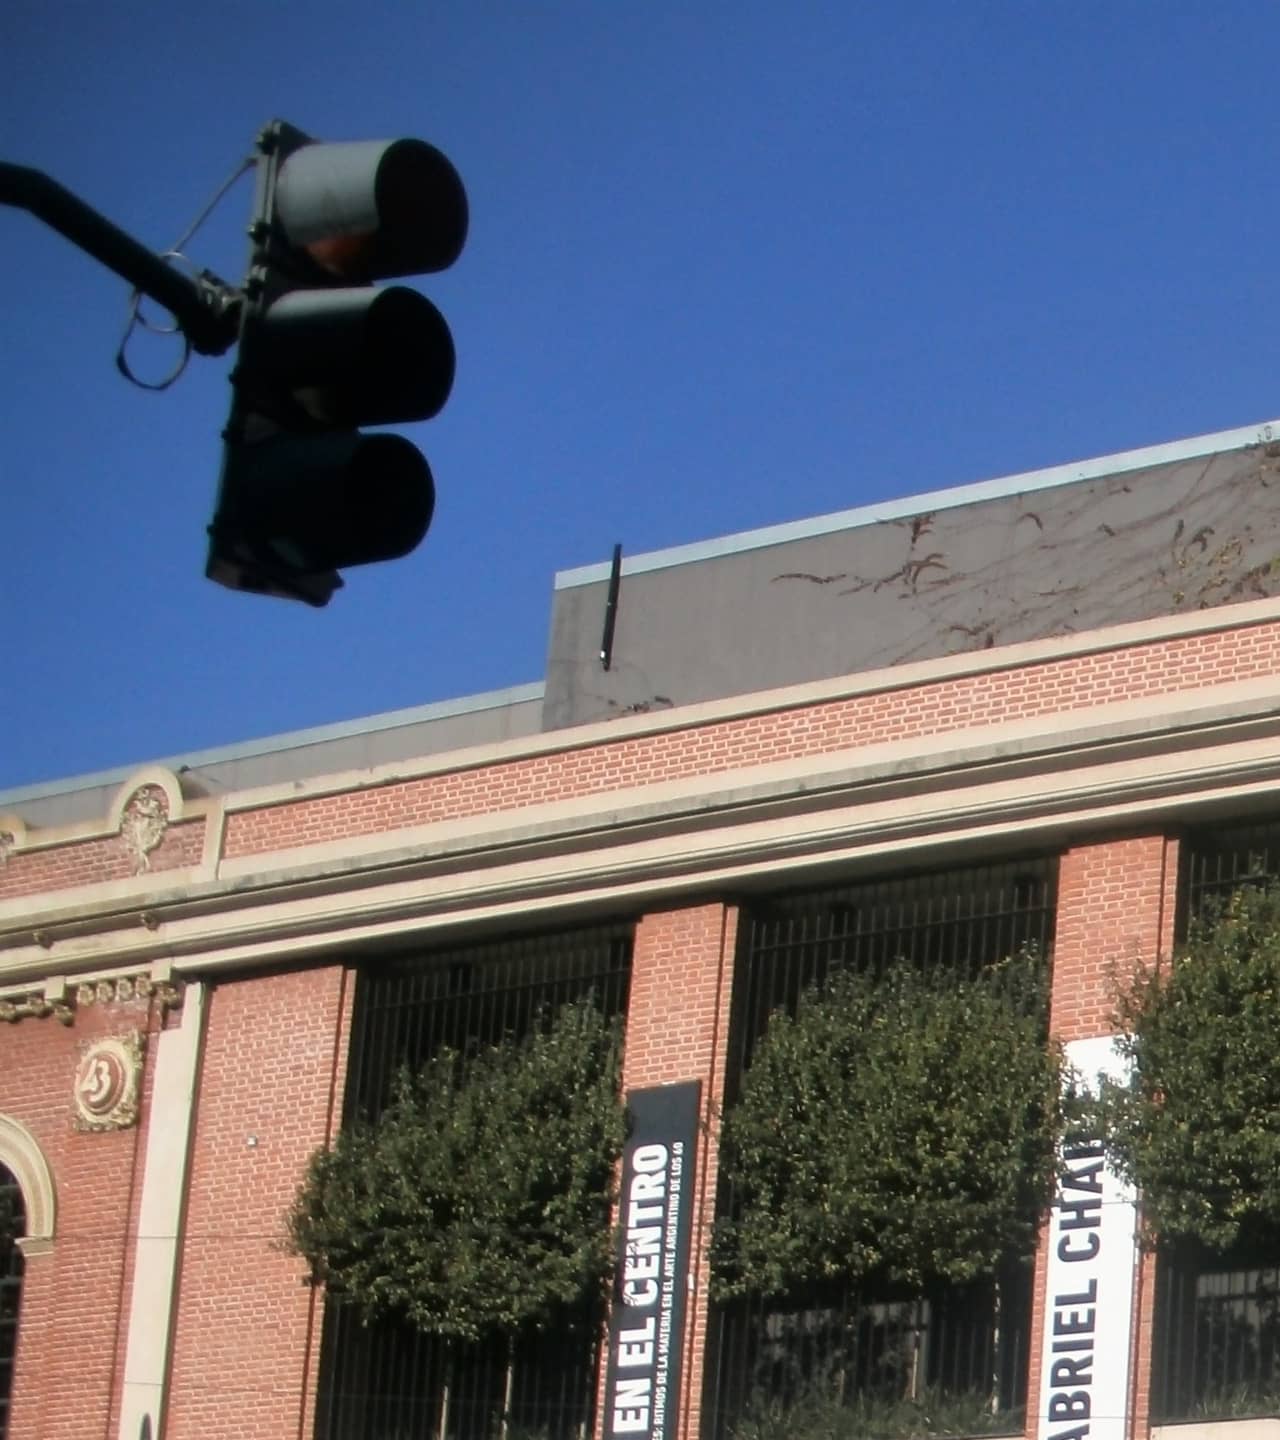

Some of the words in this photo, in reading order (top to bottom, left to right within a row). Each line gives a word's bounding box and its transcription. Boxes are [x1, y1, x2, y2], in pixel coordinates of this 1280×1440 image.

[672, 1141, 684, 1156] 60
[671, 1157, 683, 1177] LOS
[669, 1177, 681, 1191] DE
[1057, 1142, 1105, 1263] CHAI
[623, 1143, 669, 1307] CENTRO
[663, 1250, 677, 1275] ARTE
[663, 1274, 674, 1291] EL
[663, 1292, 674, 1310] EN
[617, 1316, 656, 1367] EL
[657, 1353, 669, 1367] LA
[657, 1368, 668, 1385] DE
[612, 1378, 653, 1433] EN
